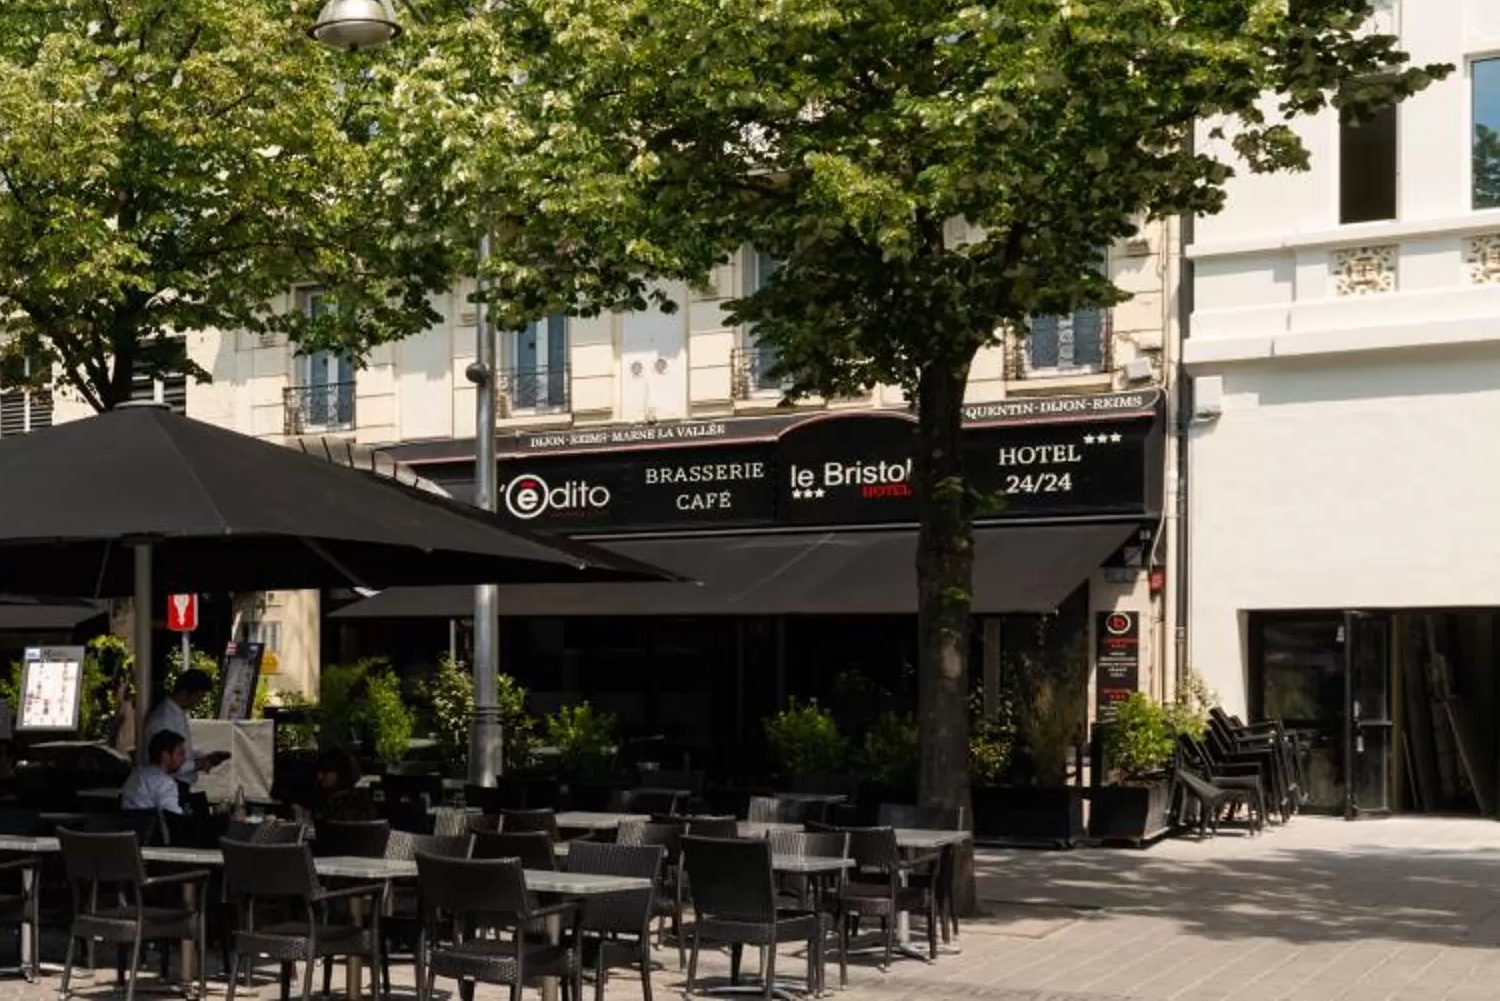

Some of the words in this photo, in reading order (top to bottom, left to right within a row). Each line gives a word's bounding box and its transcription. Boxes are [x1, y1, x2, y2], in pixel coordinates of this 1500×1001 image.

[657, 427, 674, 438] LA
[998, 444, 1081, 466] HOTEL
[645, 462, 765, 484] BRASSERIE
[790, 464, 815, 488] le
[823, 458, 912, 486] Bristol
[1005, 472, 1073, 494] 24/24
[675, 490, 732, 510] CAFÉ
